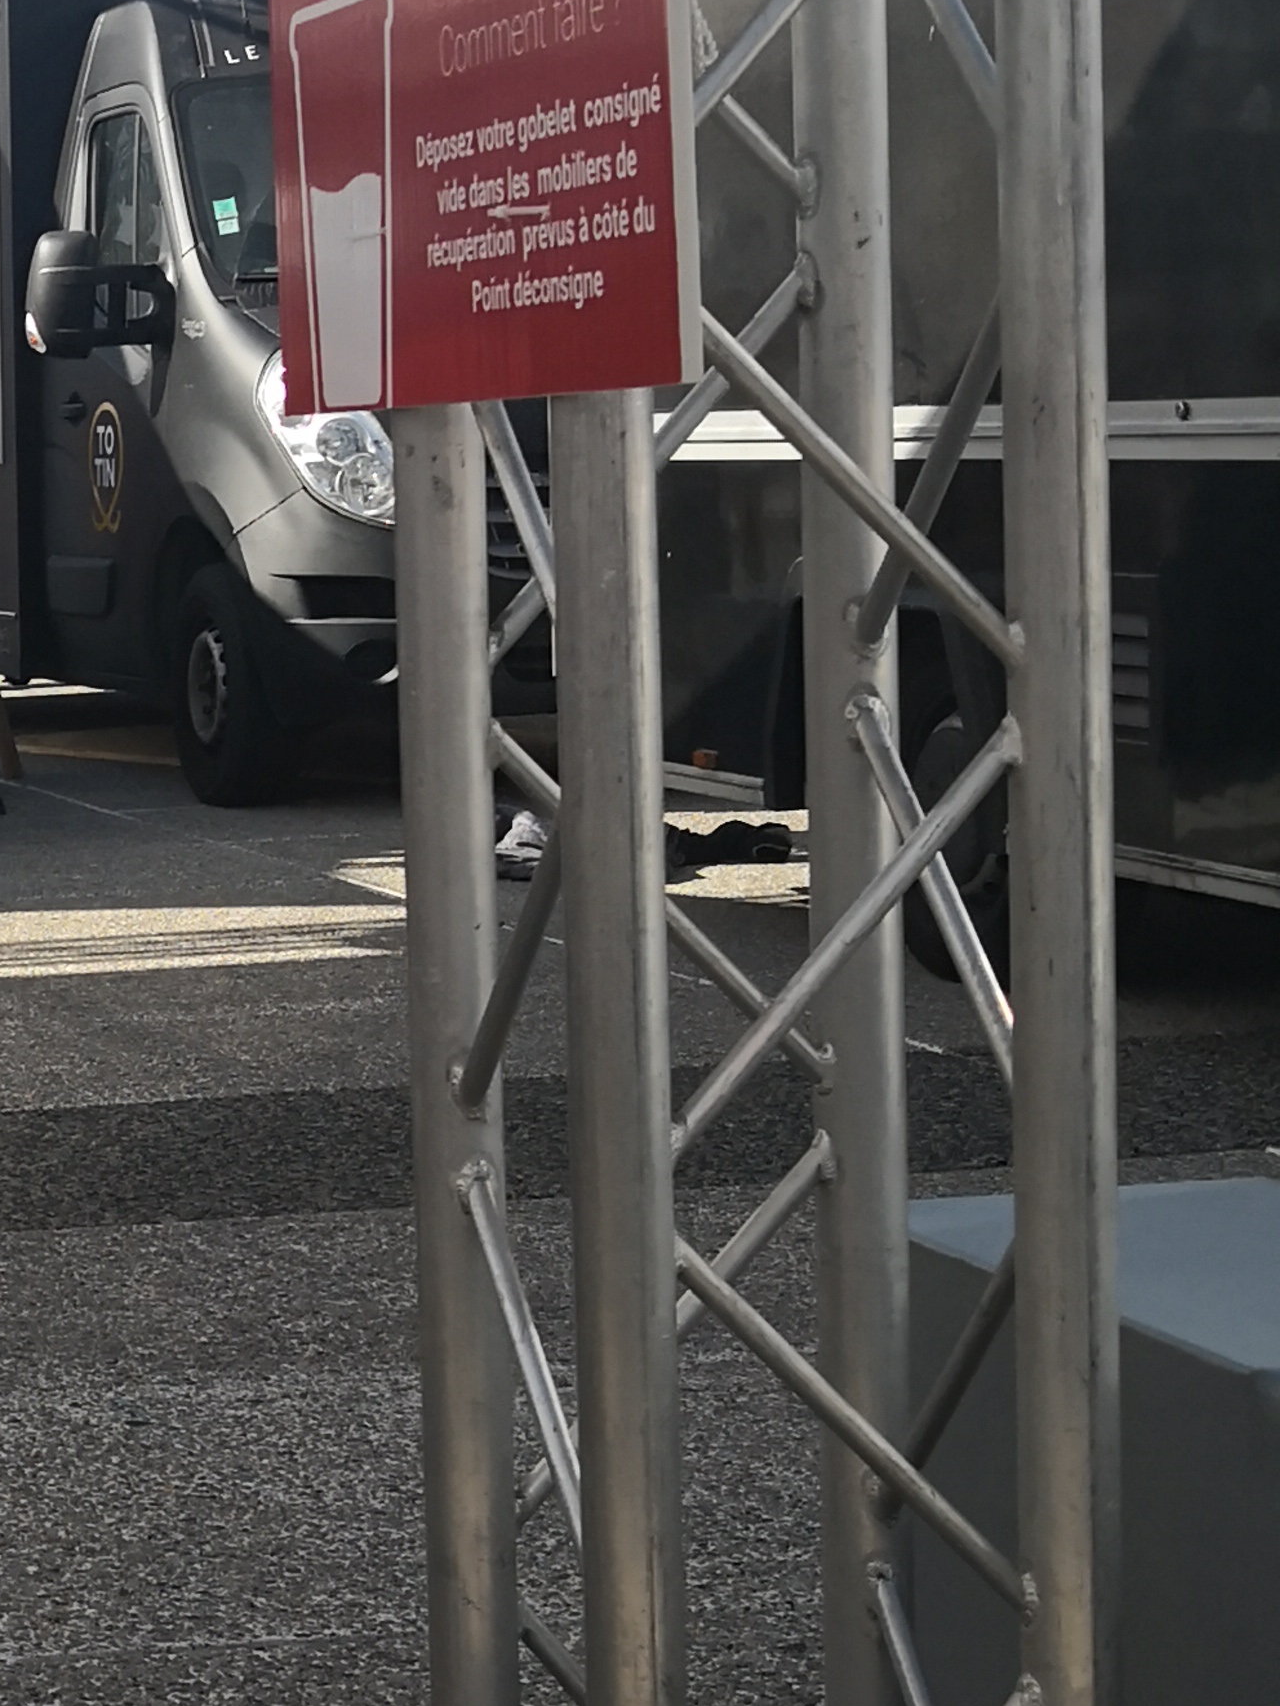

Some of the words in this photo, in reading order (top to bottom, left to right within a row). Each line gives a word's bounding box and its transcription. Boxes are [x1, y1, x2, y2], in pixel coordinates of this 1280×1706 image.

[223, 44, 261, 65] LE
[439, 1, 547, 77] Comment
[415, 129, 474, 173] Déposez
[476, 115, 515, 154] votre
[517, 98, 577, 153] gobelet
[583, 72, 662, 129] consigné
[436, 179, 466, 215] vide
[468, 172, 505, 209] dans
[506, 165, 530, 201] les
[537, 148, 612, 196] mobiliers
[614, 140, 638, 180] de
[426, 221, 516, 272] récupération
[521, 207, 575, 263] prévus
[578, 206, 589, 243] à
[592, 197, 629, 241] côté
[633, 195, 656, 234] du
[471, 275, 511, 313] Point
[513, 264, 605, 310] déconsigne
[96, 424, 115, 456] TO
[94, 457, 116, 489] TIN
